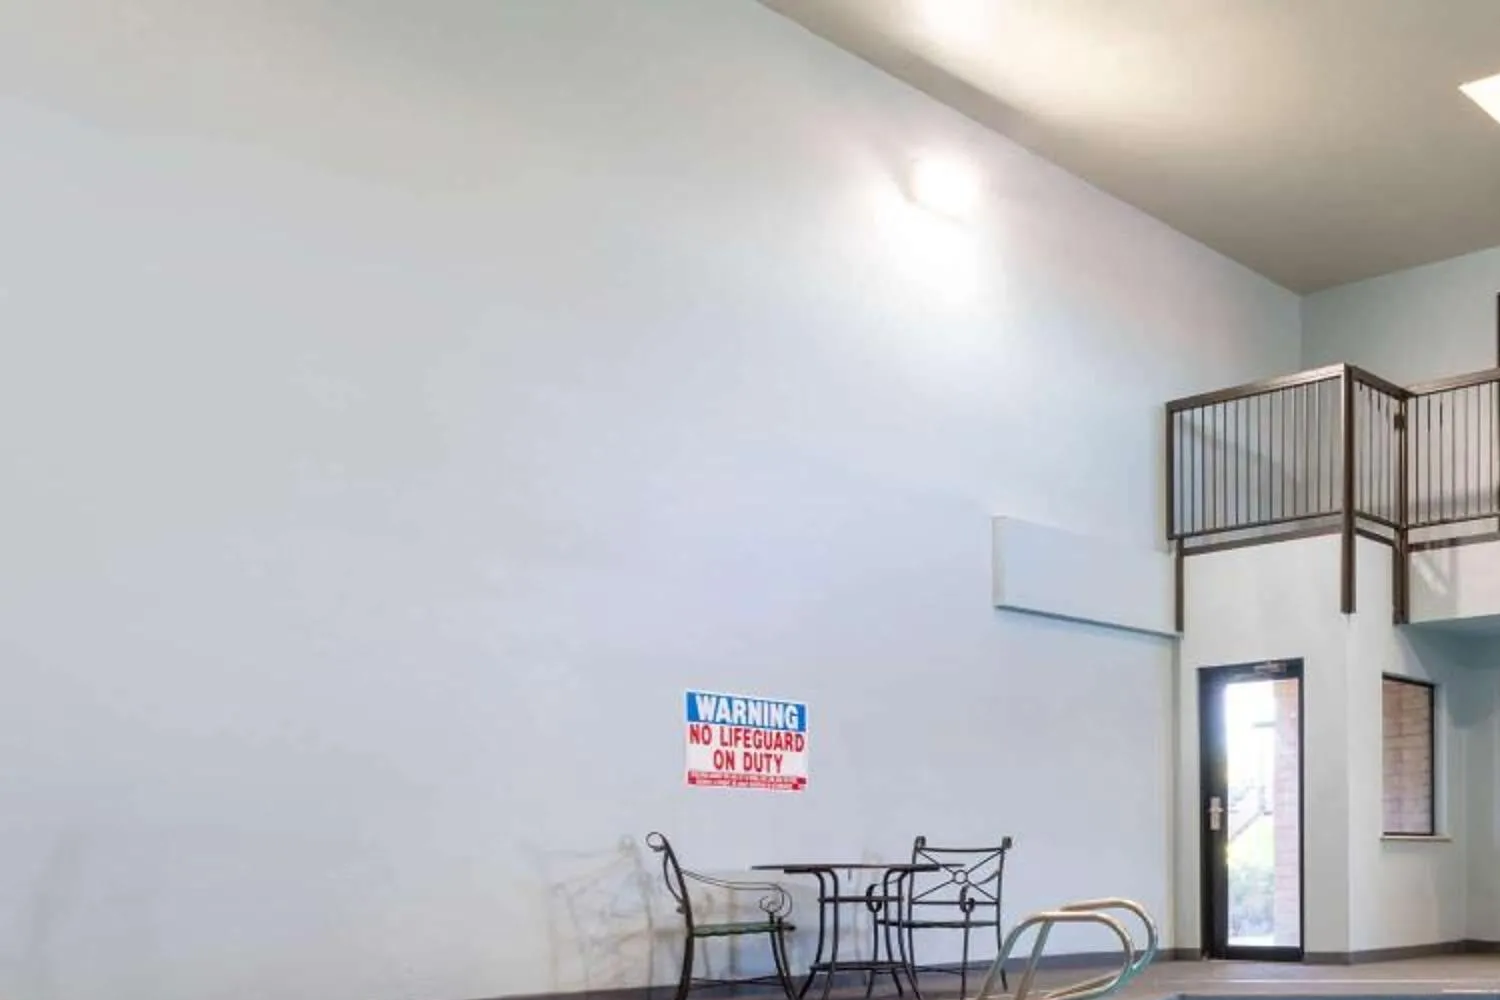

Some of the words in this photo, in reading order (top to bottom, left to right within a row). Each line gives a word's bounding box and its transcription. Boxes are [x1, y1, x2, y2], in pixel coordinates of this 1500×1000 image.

[695, 694, 799, 729] WARNING
[690, 724, 712, 745] NO
[720, 726, 805, 752] LIFEGUARD
[713, 749, 735, 771] ON
[743, 752, 783, 773] DUTY
